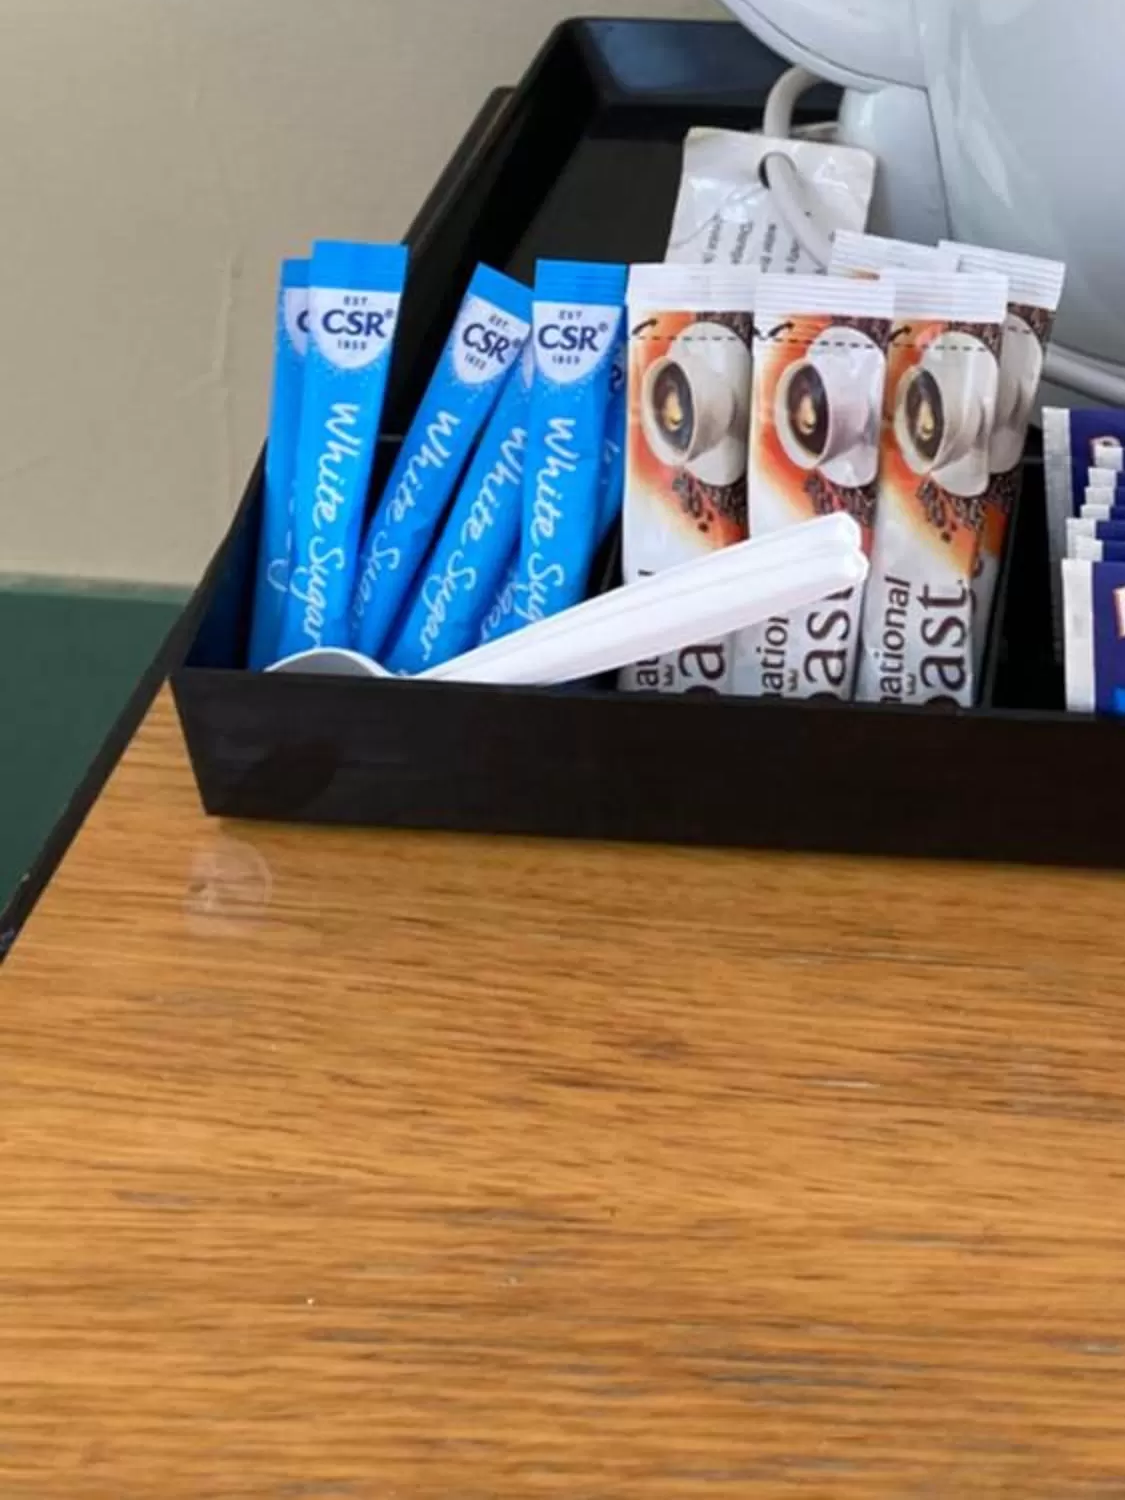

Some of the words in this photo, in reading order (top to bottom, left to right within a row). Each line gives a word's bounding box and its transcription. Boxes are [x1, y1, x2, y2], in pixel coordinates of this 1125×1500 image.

[321, 308, 386, 338] CSR
[462, 322, 505, 364] CSR
[538, 323, 598, 351] CSR
[313, 401, 362, 530] White
[388, 410, 461, 524] White
[461, 425, 528, 547] White
[532, 416, 577, 550] White
[290, 534, 346, 649] Sugar
[418, 551, 477, 662] Sugar
[512, 551, 565, 624] Sug
